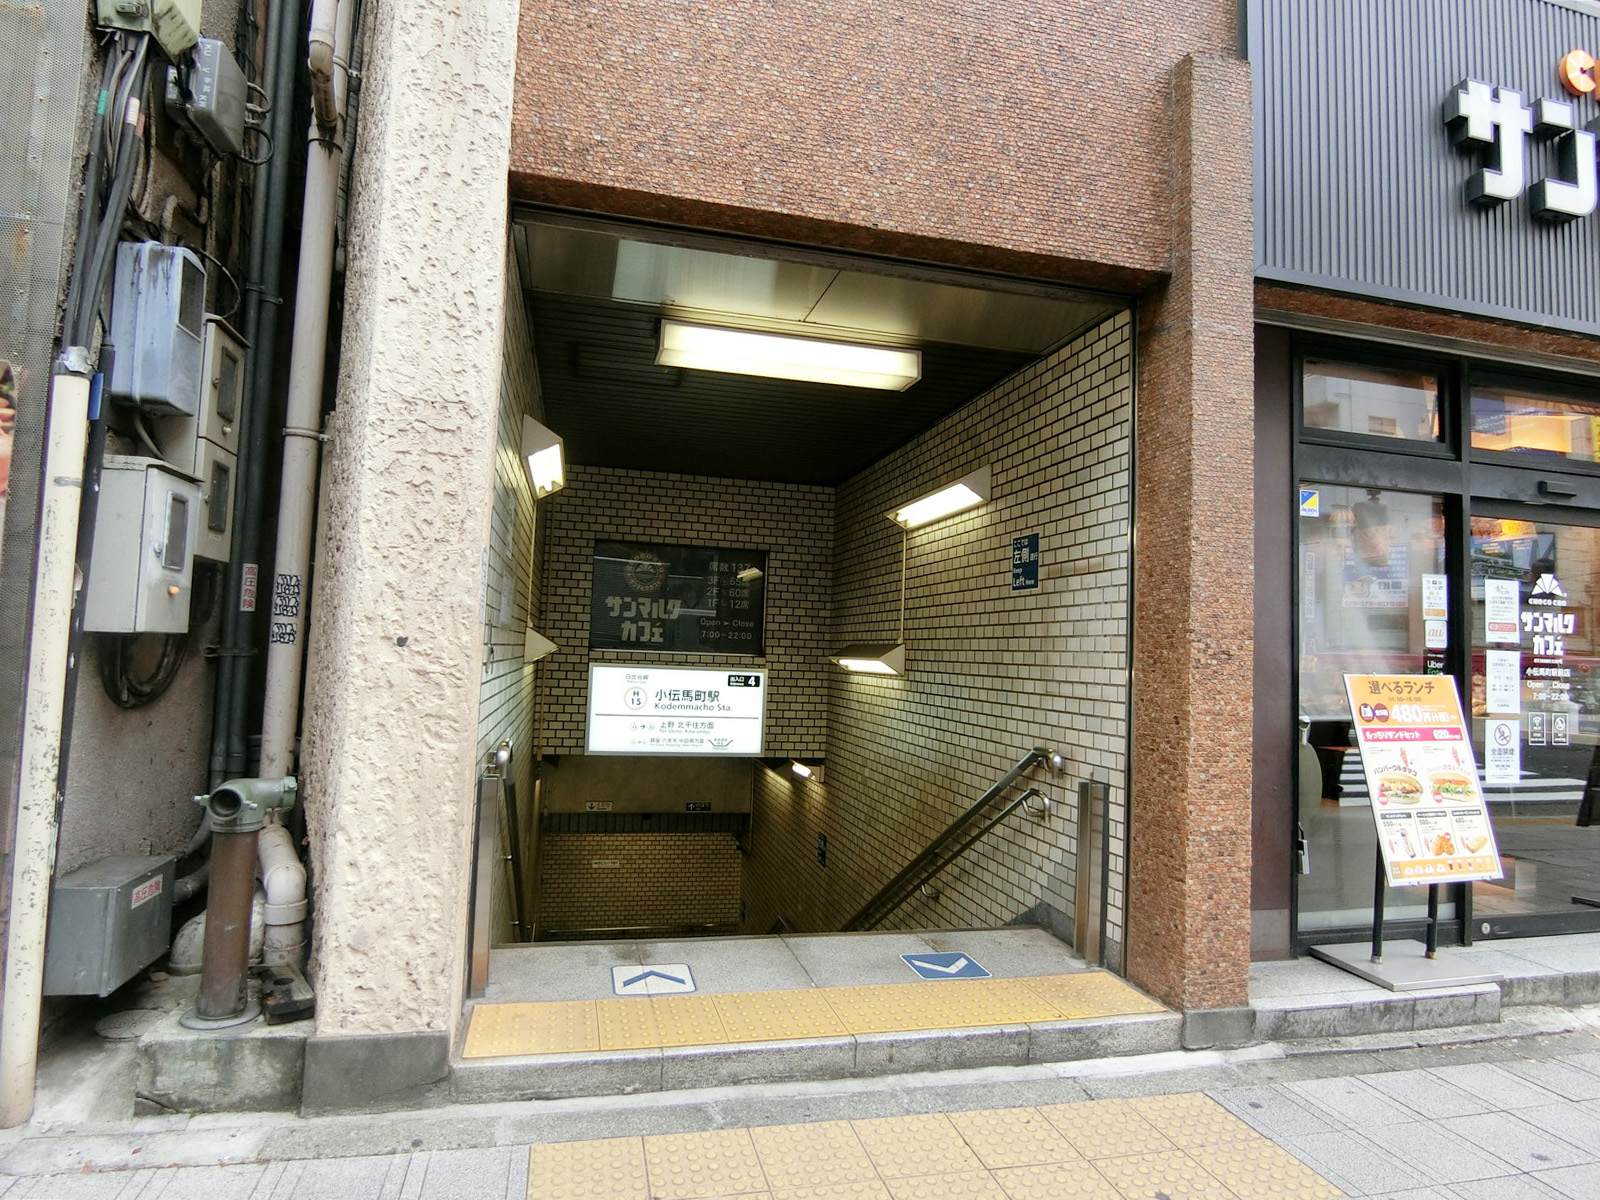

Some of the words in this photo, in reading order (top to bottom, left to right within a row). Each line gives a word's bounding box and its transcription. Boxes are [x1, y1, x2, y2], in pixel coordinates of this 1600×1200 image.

[1444, 76, 1600, 224] サン
[1012, 576, 1025, 588] Left
[706, 587, 719, 597] 2F
[605, 595, 682, 620] サンマルク
[1528, 598, 1552, 606] CHOCO
[700, 618, 720, 627] Open
[732, 620, 755, 628] Close
[1520, 611, 1576, 635] サンマルク
[621, 620, 664, 643] カフェ
[1532, 634, 1565, 656] カフェ
[1427, 660, 1444, 669] Uber
[747, 676, 756, 687] 4
[1368, 680, 1436, 695] 選べるランチ
[1526, 680, 1544, 690] Open
[1551, 681, 1571, 690] Close
[654, 688, 721, 703] 小伝馬町駅
[654, 702, 715, 711] Kodemmacho
[717, 703, 734, 712] Sta.
